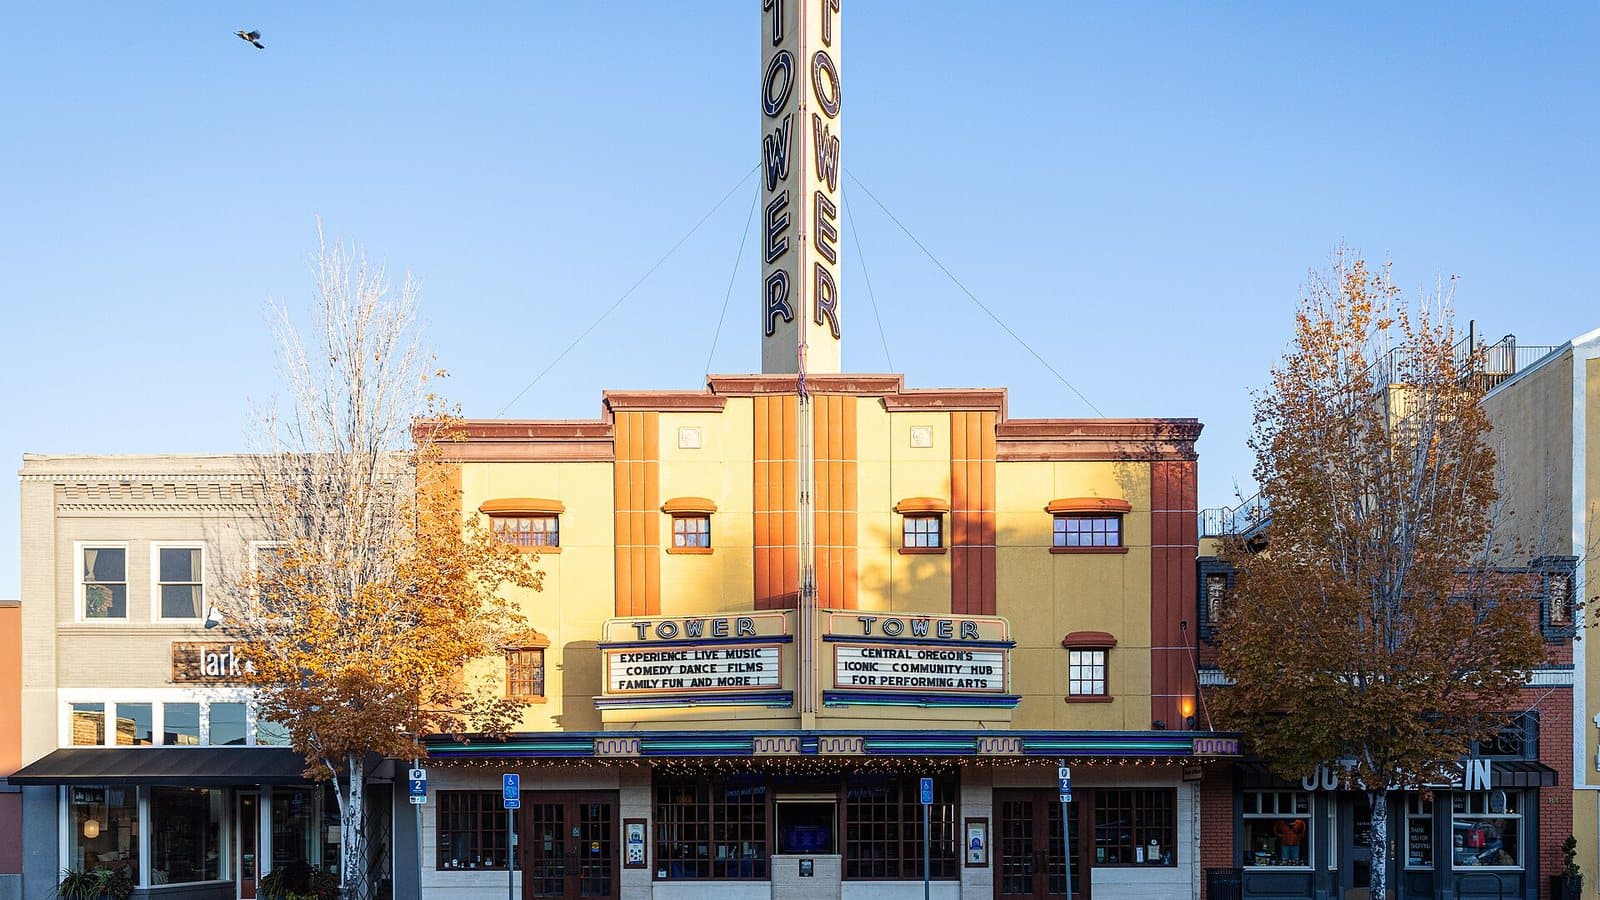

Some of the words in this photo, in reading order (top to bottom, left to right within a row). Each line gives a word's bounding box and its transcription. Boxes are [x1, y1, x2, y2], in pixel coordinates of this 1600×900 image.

[762, 0, 796, 337] TOWER
[811, 0, 842, 340] TOWER
[632, 617, 756, 640] TOWER
[859, 615, 980, 639] TOWER
[200, 645, 242, 676] lark
[620, 651, 688, 663] EXPERIENCE
[694, 650, 719, 661] LIVE
[725, 648, 762, 660] MUSIC
[861, 648, 912, 659] CENTRAL
[917, 650, 973, 661] OREGON'S
[626, 665, 674, 676] COMEDY
[680, 663, 717, 674] DANCE
[727, 662, 763, 673] FILMS
[844, 661, 879, 672] ICONIC
[892, 662, 962, 674] COMMUNITY
[970, 665, 993, 675] HUB
[618, 679, 660, 690] FAMILY
[662, 678, 684, 688] FUN
[690, 677, 713, 688] AND
[851, 675, 877, 685] FOR
[880, 676, 953, 687] PERFORMING
[956, 678, 988, 688] ARTS
[1465, 759, 1492, 790] IN
[415, 780, 421, 789] 2
[1062, 779, 1068, 788] 2
